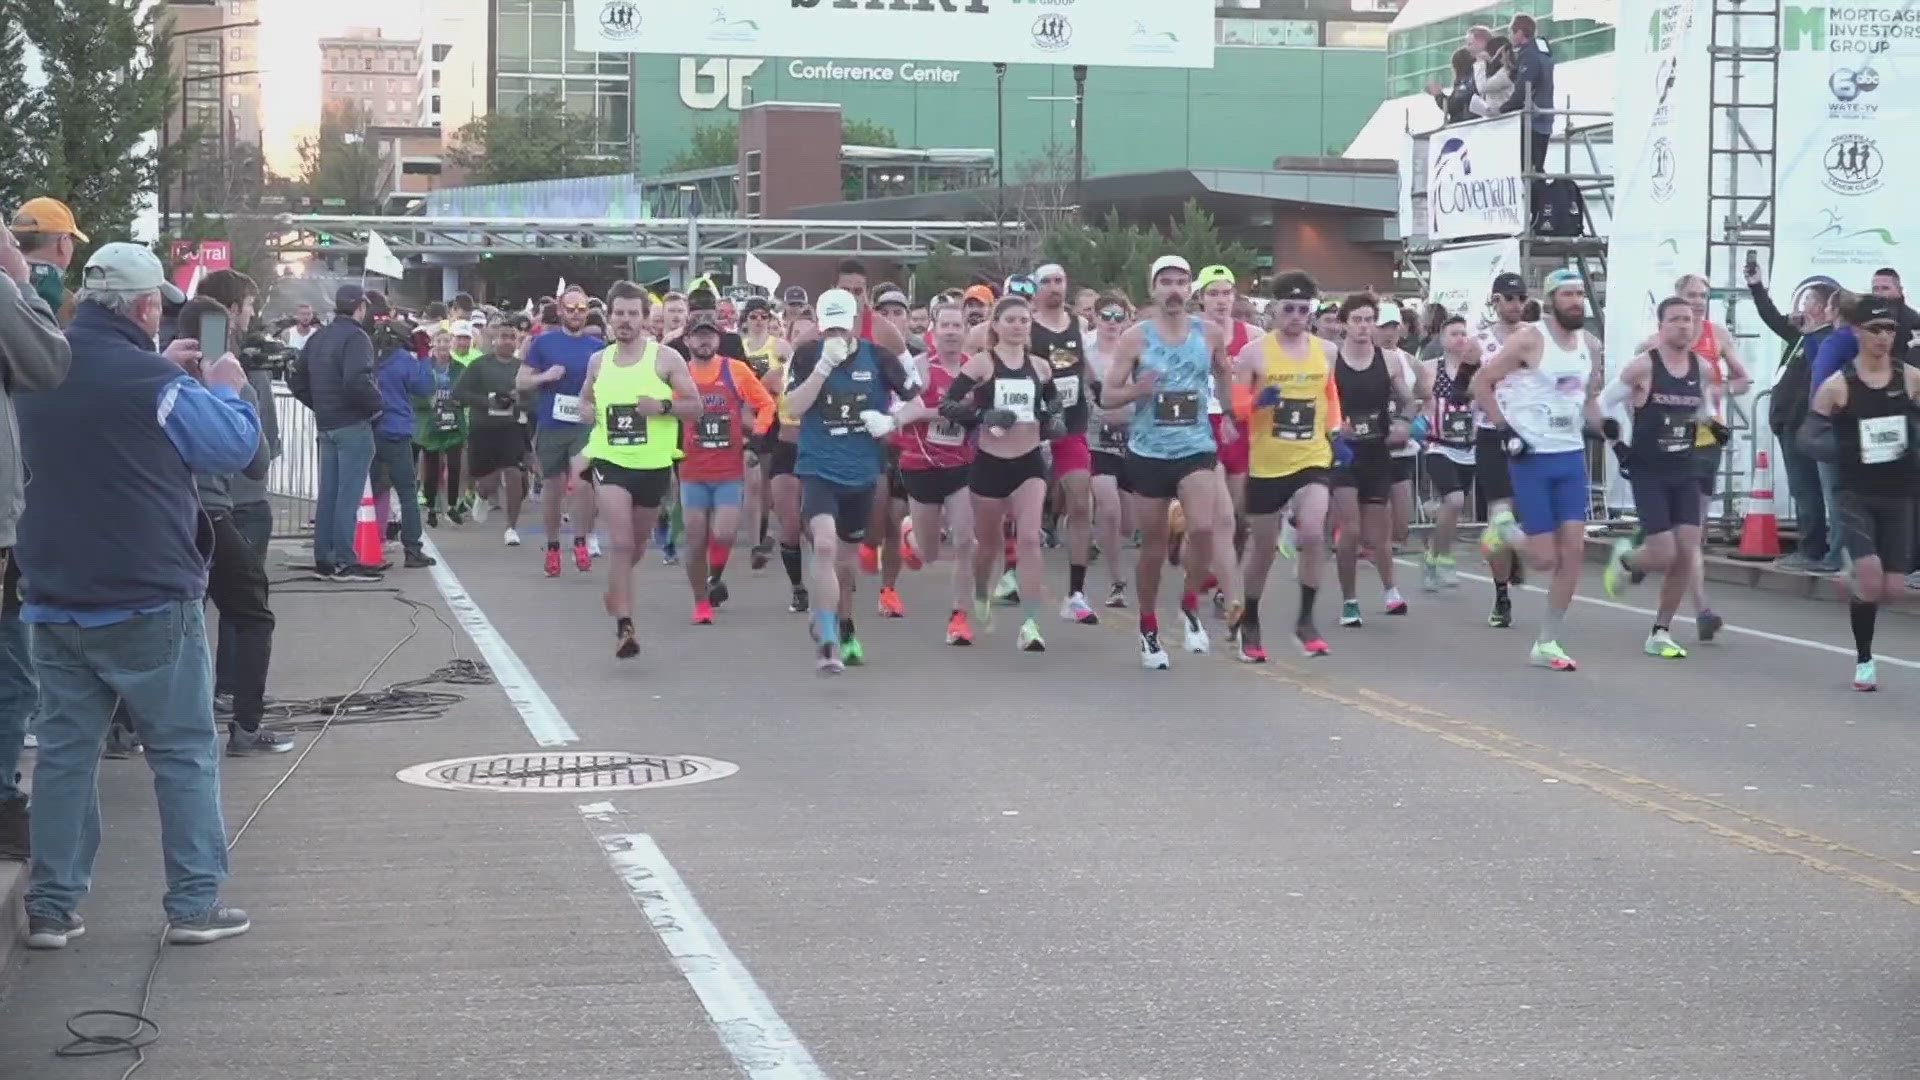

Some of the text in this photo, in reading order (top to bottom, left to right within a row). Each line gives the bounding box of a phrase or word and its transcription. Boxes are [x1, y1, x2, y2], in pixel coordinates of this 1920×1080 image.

[1829, 23, 1920, 38] INVESTORS
[1830, 39, 1890, 54] GROUP
[788, 59, 960, 83] Conference Center
[679, 56, 764, 109] UT
[1829, 104, 1879, 112] WATE-TV
[841, 405, 850, 419] 2
[1173, 404, 1180, 418] 1
[617, 416, 633, 429] 22
